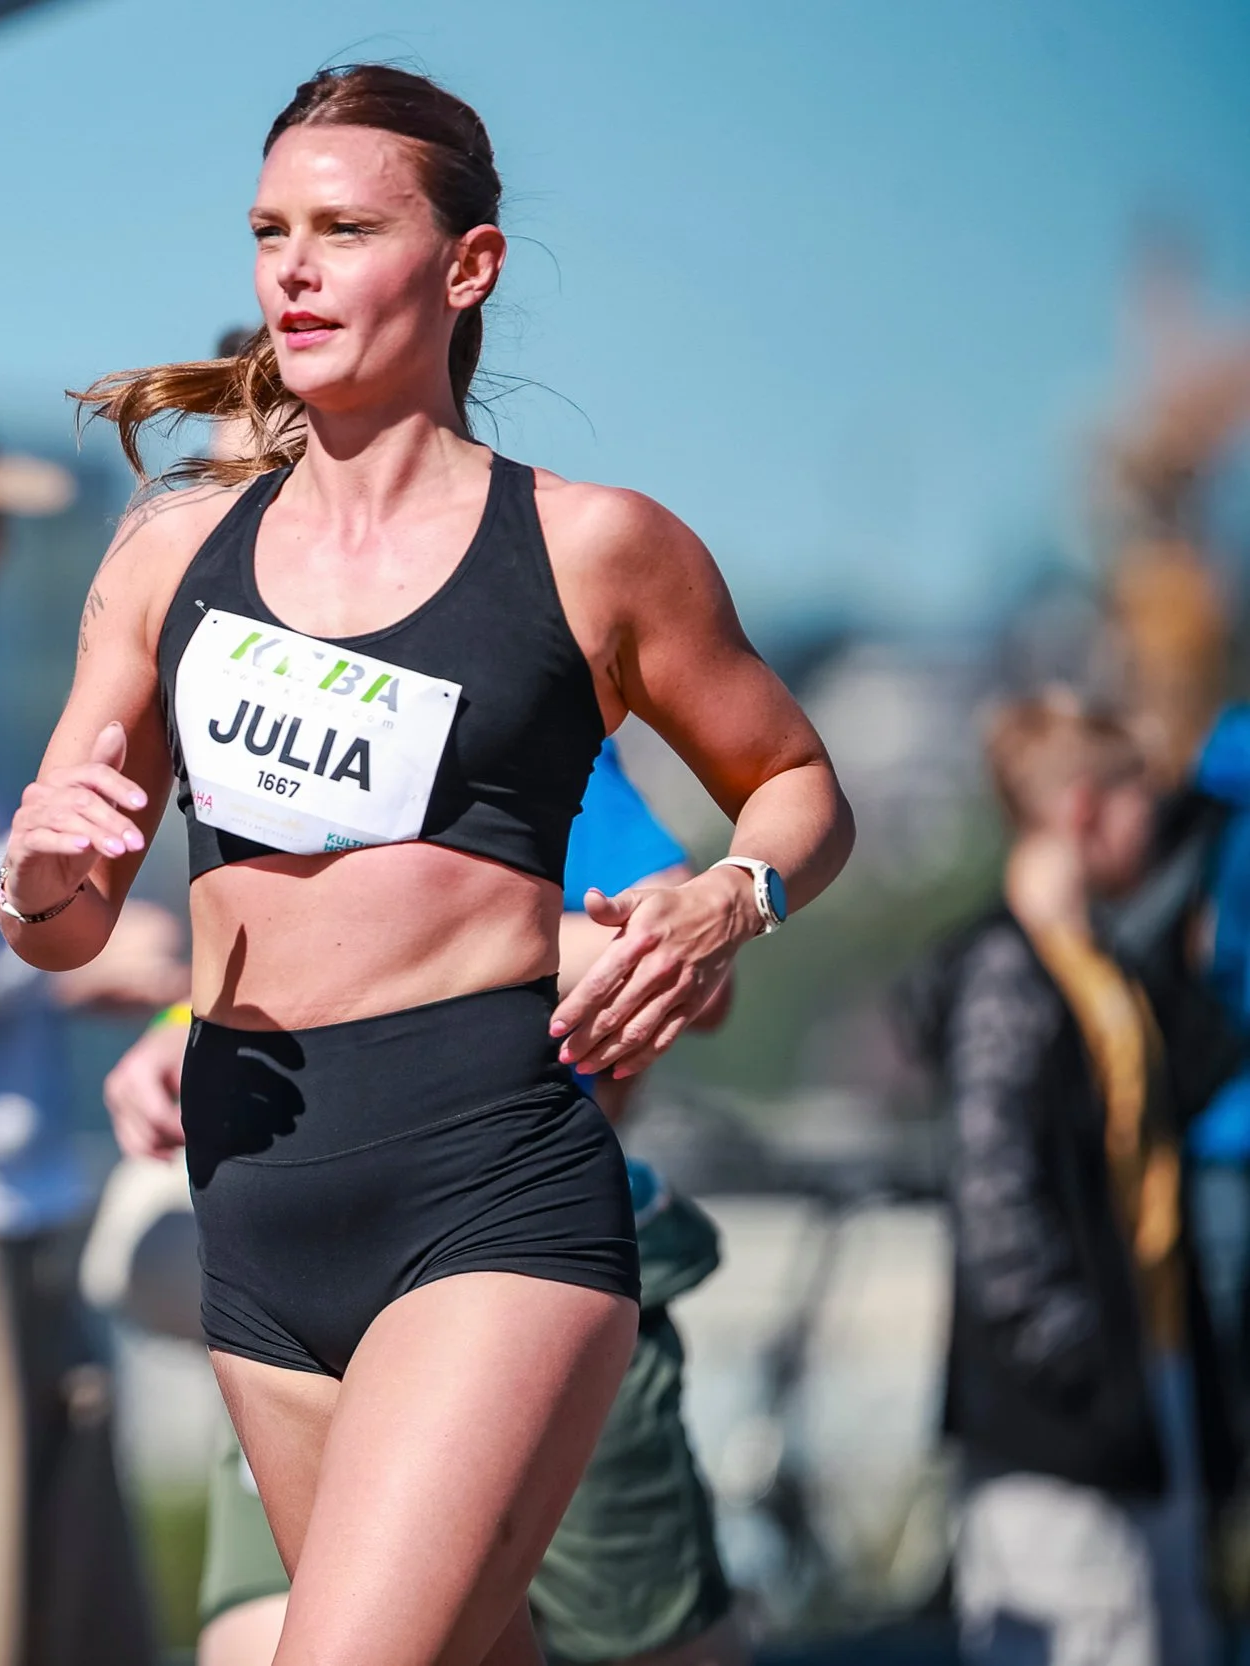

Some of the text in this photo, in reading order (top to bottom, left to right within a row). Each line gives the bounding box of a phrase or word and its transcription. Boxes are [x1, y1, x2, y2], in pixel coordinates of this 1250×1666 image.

[230, 632, 400, 713] KBA
[208, 700, 371, 792] JULIA
[257, 771, 301, 798] 1667
